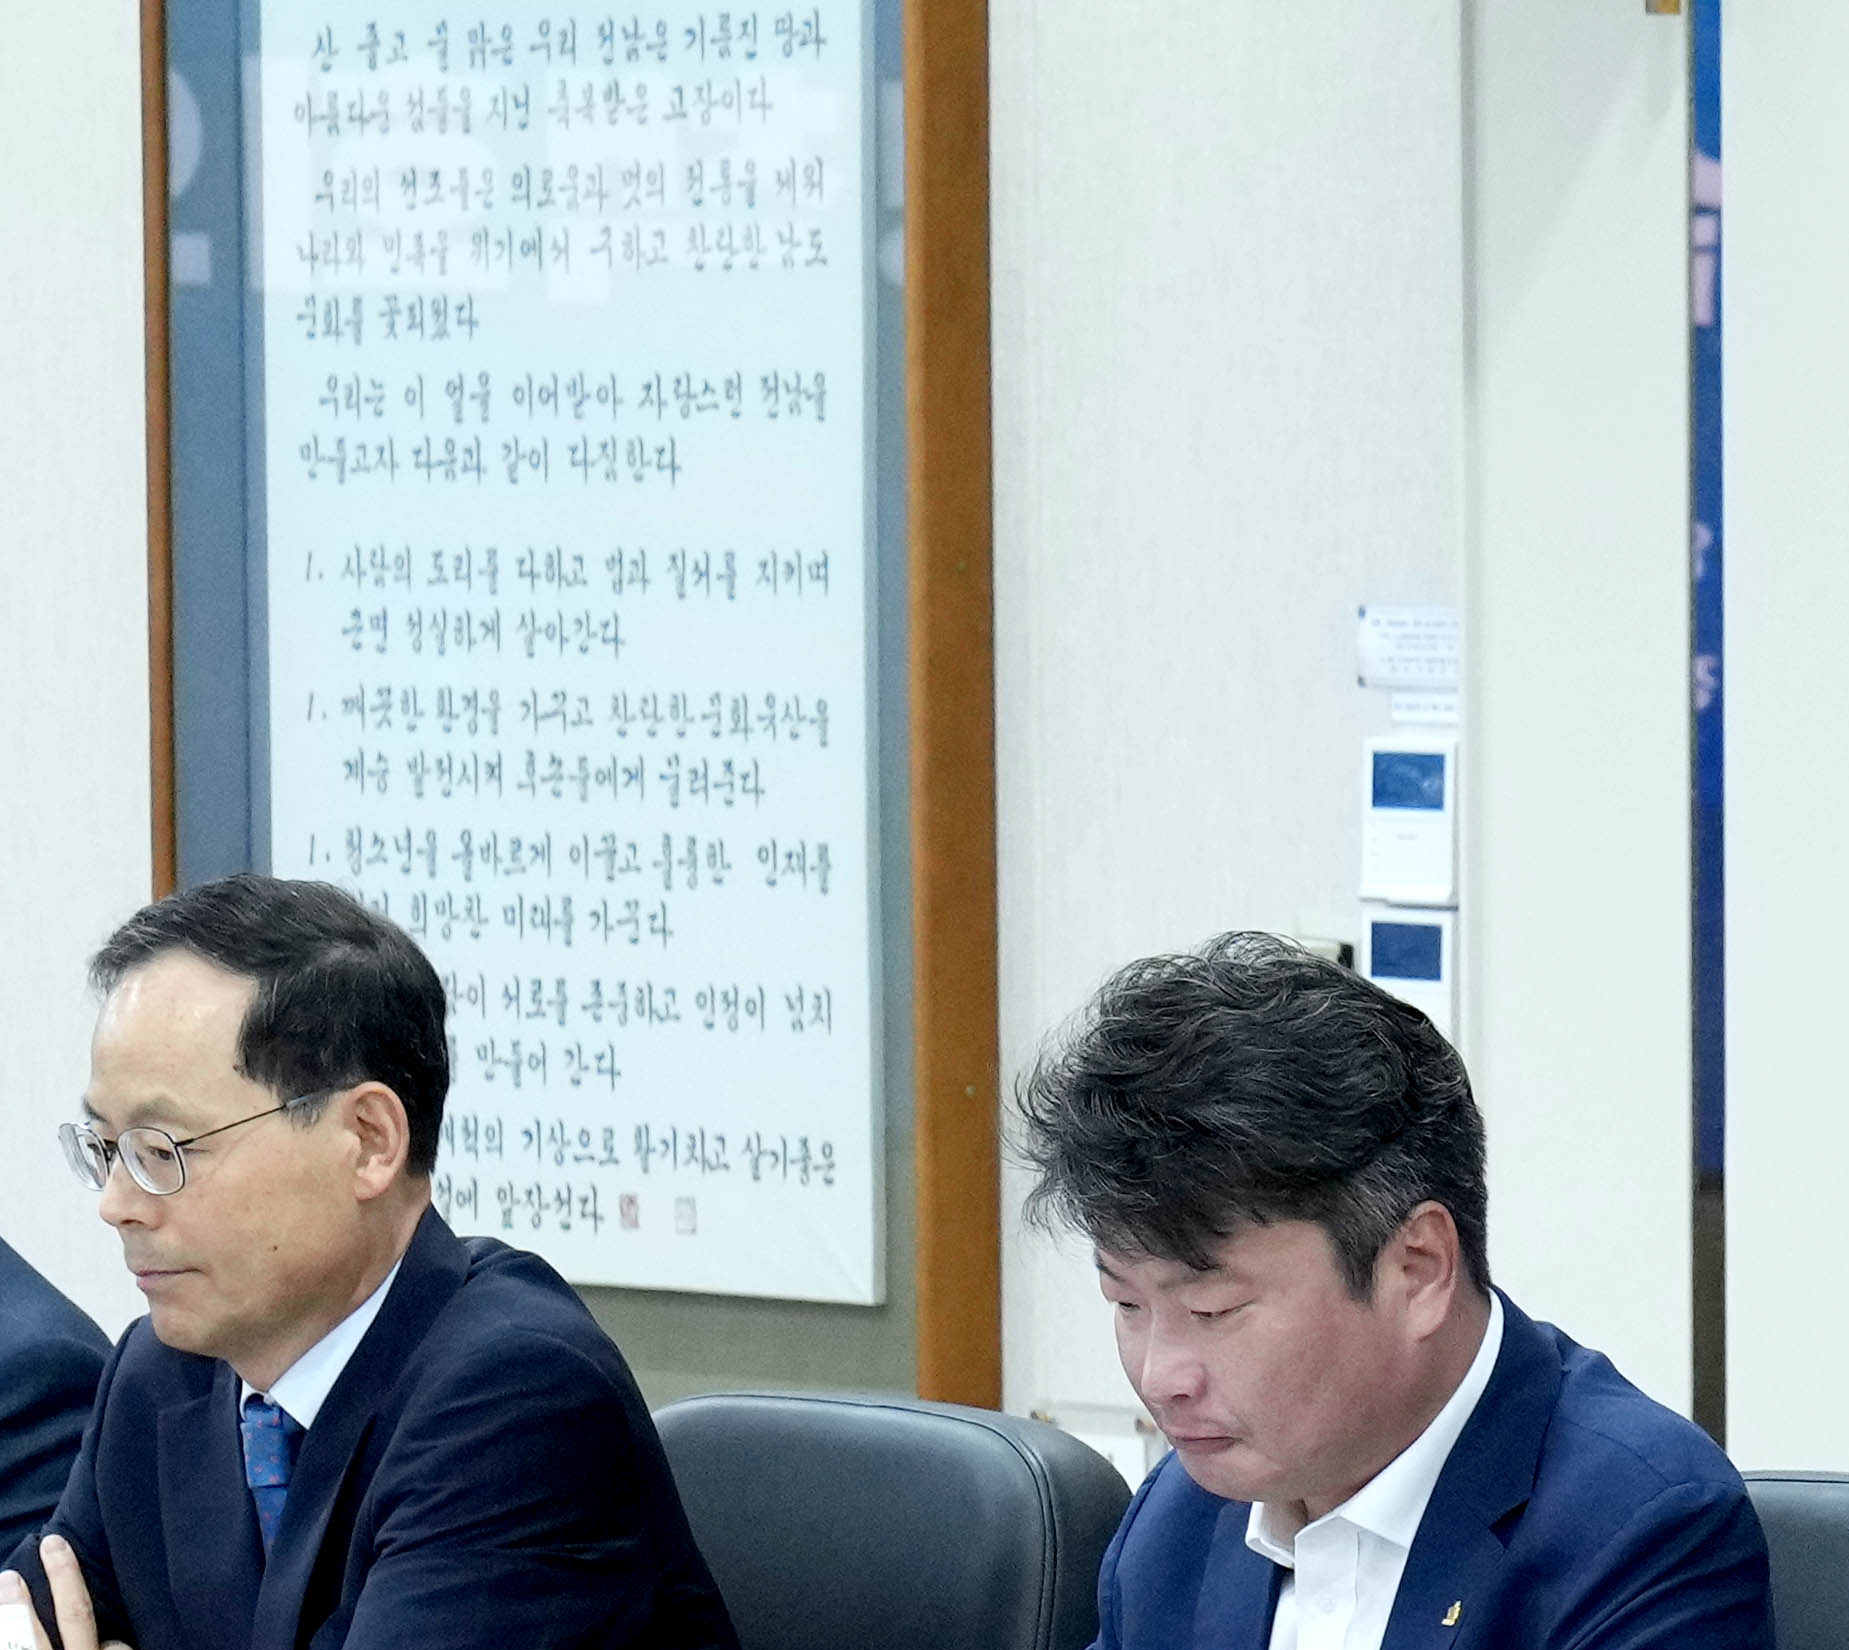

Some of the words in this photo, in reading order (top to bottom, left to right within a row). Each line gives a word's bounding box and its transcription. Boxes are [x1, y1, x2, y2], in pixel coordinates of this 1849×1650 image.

[311, 24, 340, 74] 산
[356, 19, 409, 72] 좋고
[426, 18, 450, 73] 물
[467, 19, 514, 71] 맑은
[528, 16, 577, 66] 우리
[596, 15, 669, 67] 전남은
[683, 11, 758, 62] 기름진
[293, 88, 391, 138] 아름다운
[486, 82, 530, 132] 지닌
[662, 75, 774, 127] 고장이다
[314, 165, 380, 213] 우리의
[399, 165, 494, 212] 선조들은
[686, 158, 757, 210] 전통을
[776, 155, 824, 208] 세워
[296, 227, 366, 278] 나라와
[382, 228, 449, 276] 민족을
[470, 225, 570, 274] 위기에서
[589, 224, 669, 271] 구하고
[687, 222, 767, 273] 찬란한
[776, 222, 829, 269] 남도
[296, 292, 364, 347] 문화를
[378, 292, 480, 342] 꽃피웠다
[318, 372, 386, 421] 우리는
[403, 373, 425, 420] 이
[444, 370, 492, 426] 얼을
[512, 370, 624, 422] 이어받아
[638, 369, 743, 422] 자랑스런
[759, 369, 828, 424] 전남을
[298, 433, 400, 486] 만들고자
[411, 434, 488, 485] 다음과
[501, 434, 549, 486] 같이
[567, 433, 683, 488] 다짐한다
[340, 543, 412, 592] 사람의
[426, 544, 500, 597] 도리를
[515, 544, 589, 593] 다하고
[603, 546, 652, 596] 법과
[666, 547, 738, 603] 질서를
[755, 548, 830, 597] 지키며
[406, 606, 502, 658] 성실하게
[515, 607, 627, 660] 살아간다
[340, 682, 426, 734] 깨끗한
[435, 684, 502, 737] 환경을
[519, 687, 594, 735] 가꾸고
[609, 689, 696, 740] 찬란한
[342, 746, 390, 796] 계승
[406, 748, 503, 800] 발전시켜
[515, 747, 645, 804] 후손들에게
[657, 752, 767, 810] 물려준다
[345, 824, 438, 880] 청소년을
[568, 831, 643, 884] 이끌고
[651, 831, 733, 891] 훌륭한
[756, 837, 833, 897] 인재를
[409, 889, 490, 943] 희망찬
[501, 892, 575, 949] 미래를
[587, 896, 675, 950] 가꾼다
[501, 974, 569, 1029] 서로를
[580, 977, 682, 1028] 존중하고
[694, 982, 766, 1034] 인정이
[783, 983, 832, 1035] 넘치
[474, 1036, 548, 1090] 만들어
[563, 1040, 622, 1092] 간다
[520, 1116, 621, 1168] 기상으로
[495, 1179, 606, 1236] 앞장선다
